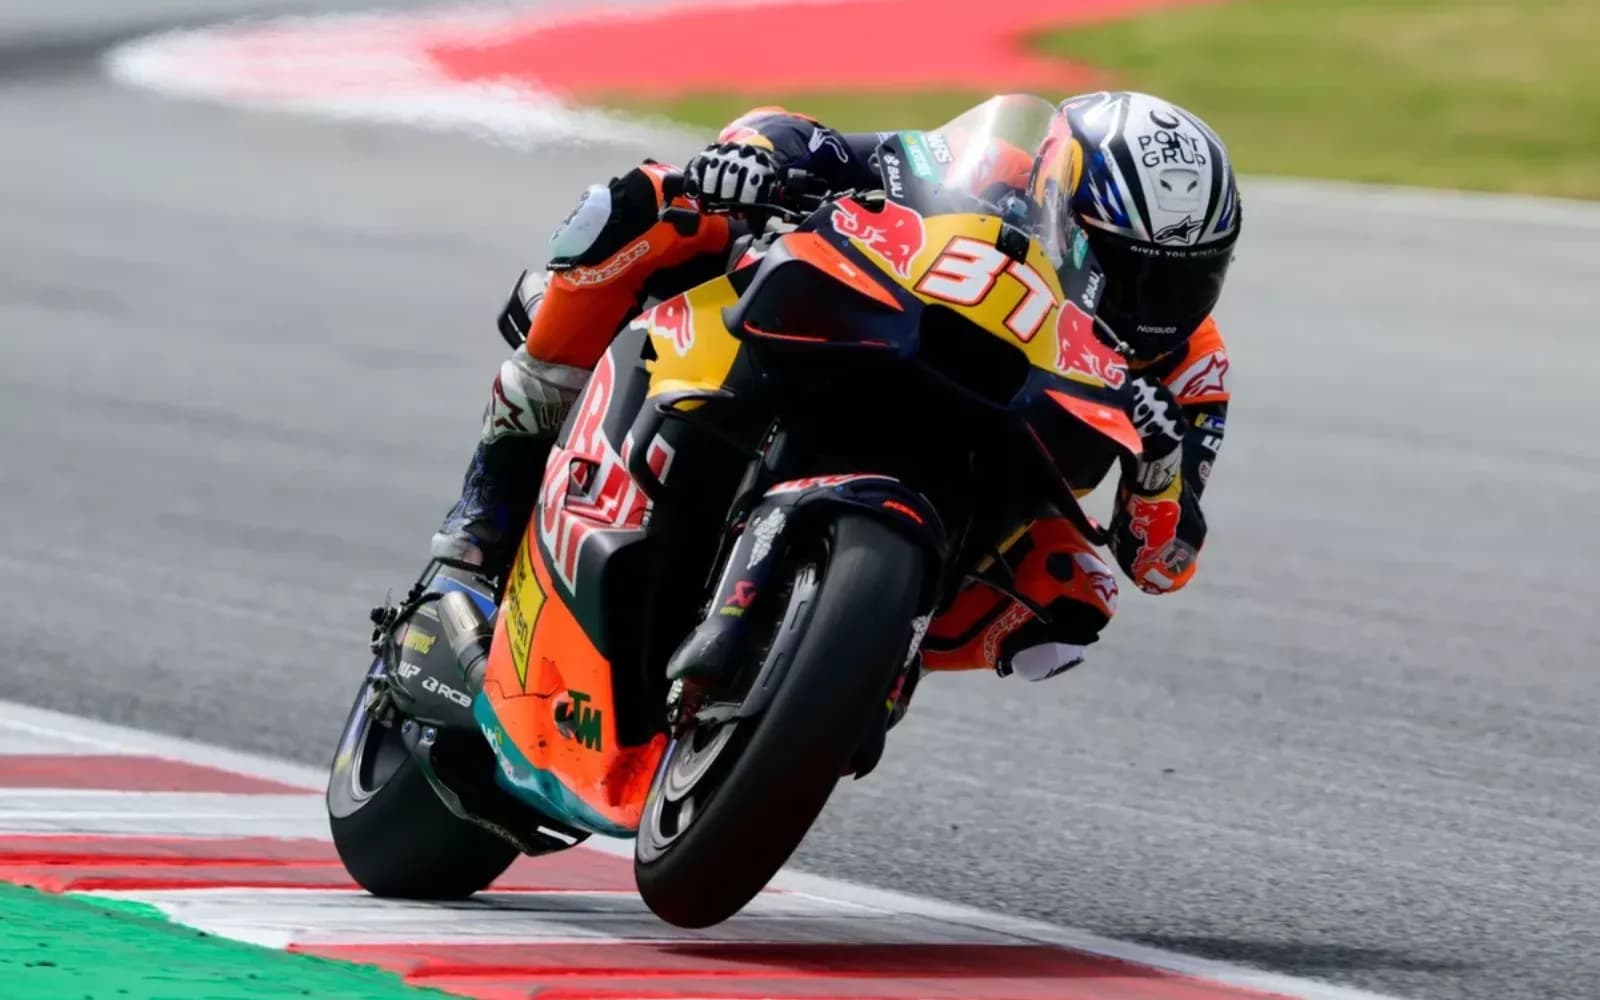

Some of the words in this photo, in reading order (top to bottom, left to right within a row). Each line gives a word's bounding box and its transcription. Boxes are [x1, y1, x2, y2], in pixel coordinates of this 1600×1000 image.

[1138, 130, 1199, 151] PONT
[1142, 148, 1207, 168] GRUP
[913, 234, 1060, 344] 37
[438, 682, 473, 708] RCB
